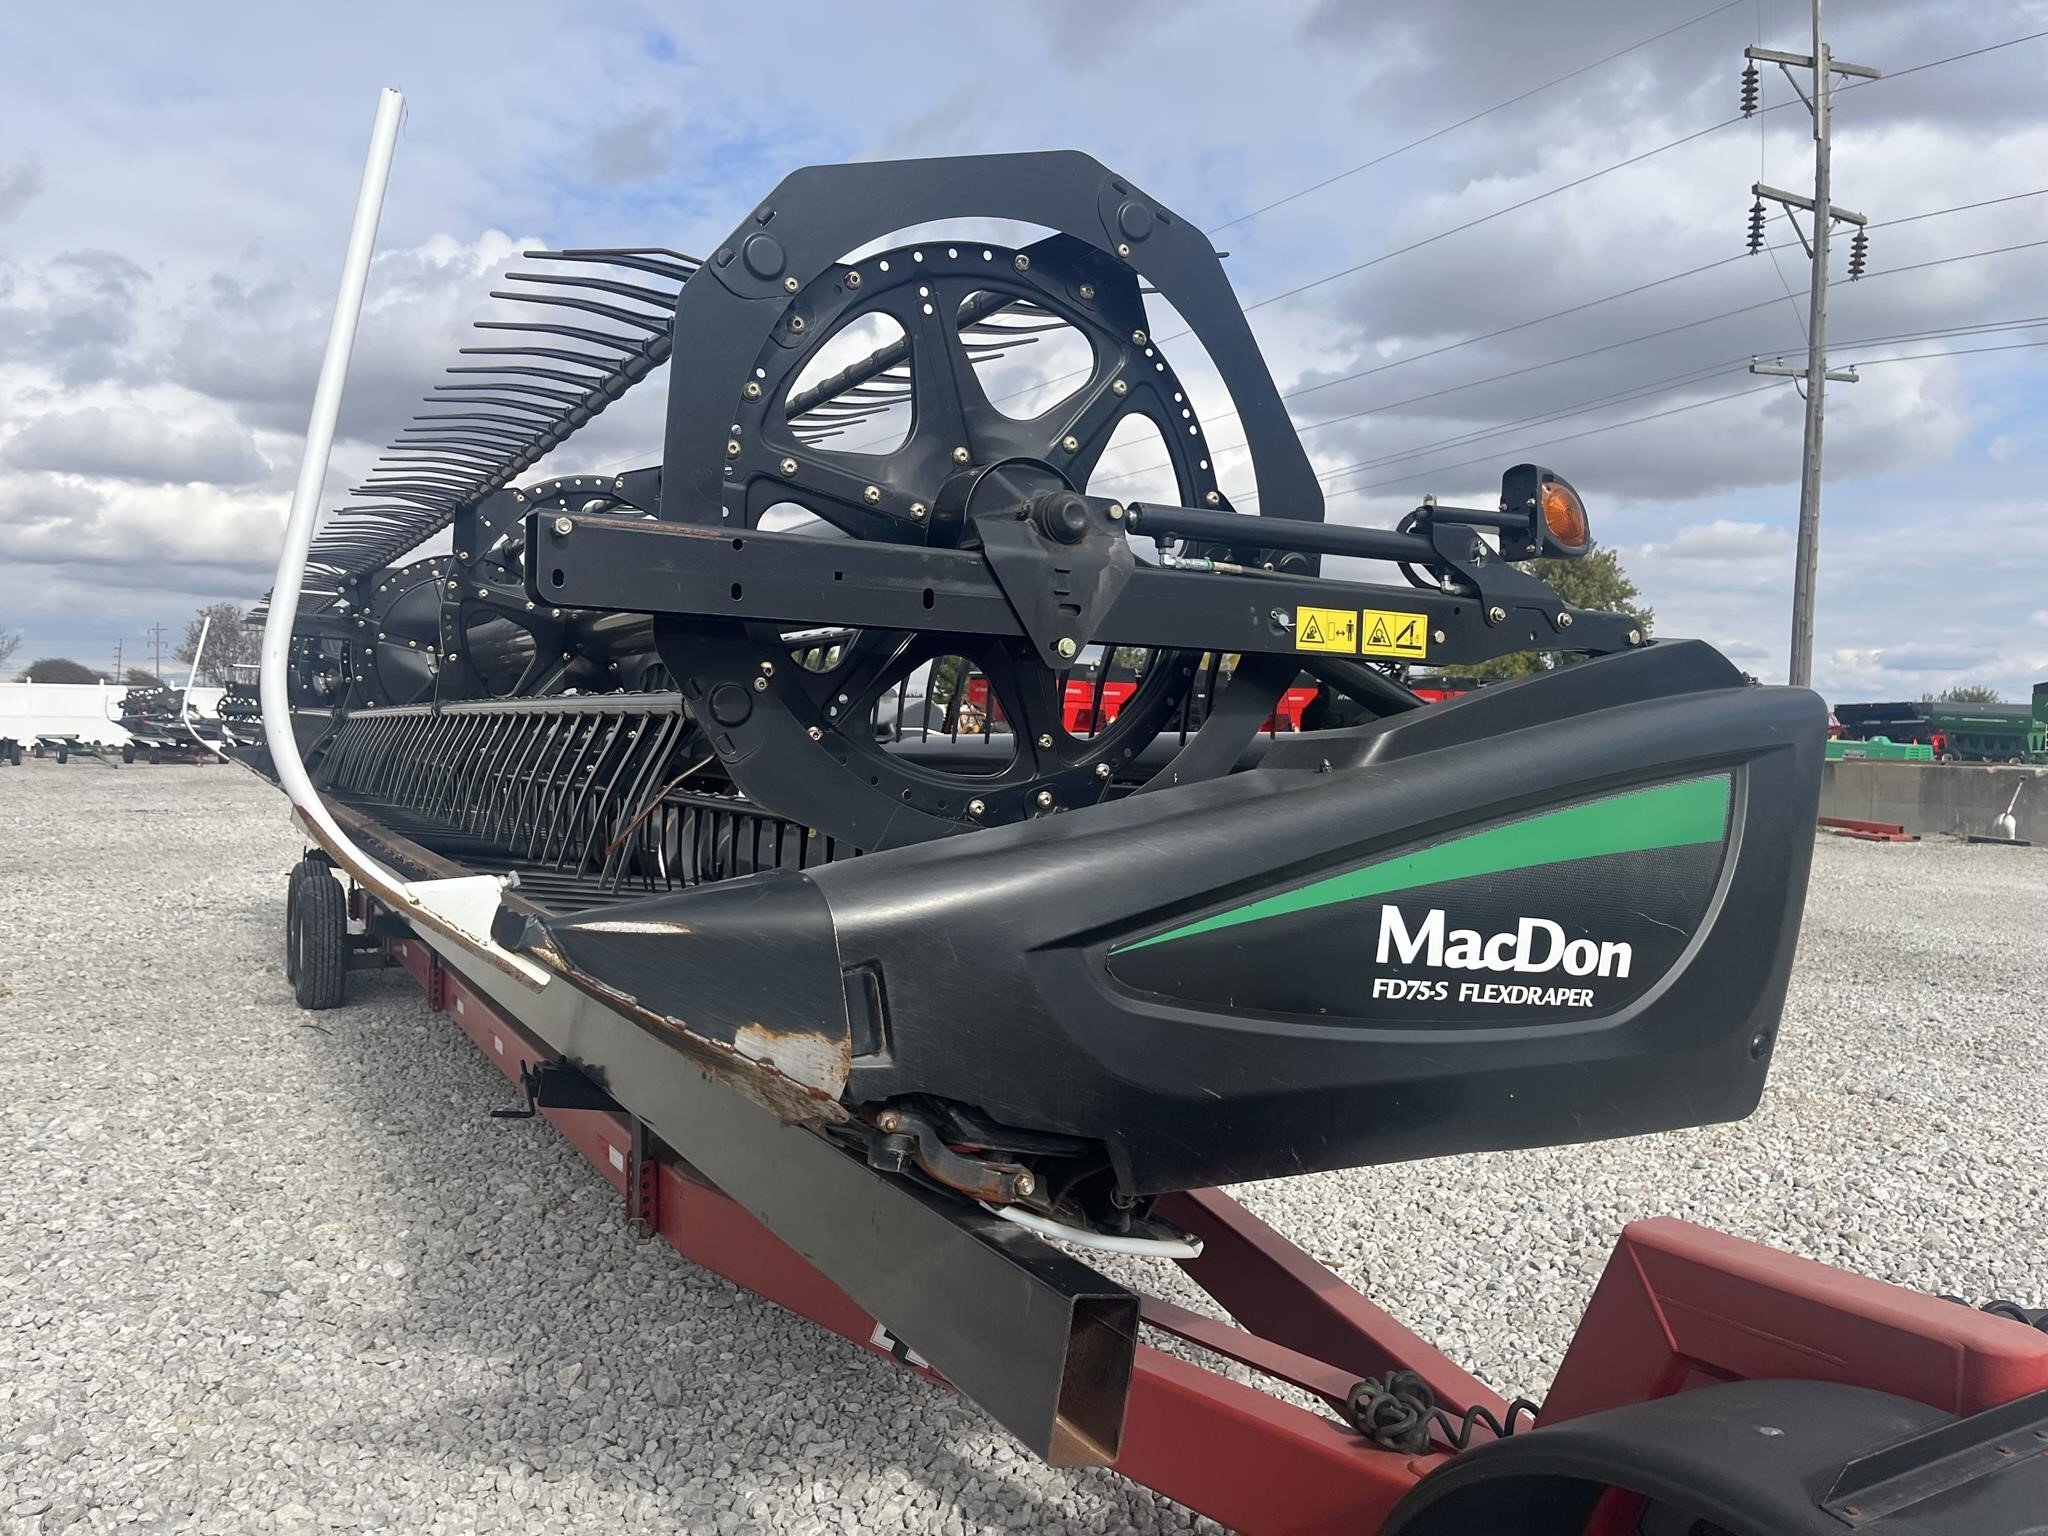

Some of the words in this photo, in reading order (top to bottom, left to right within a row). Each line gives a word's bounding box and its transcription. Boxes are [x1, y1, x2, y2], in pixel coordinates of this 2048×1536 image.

[1376, 904, 1632, 978] MacDon
[1372, 978, 1449, 1000] FD75-S
[1458, 982, 1594, 1008] FLEXDRAPER
